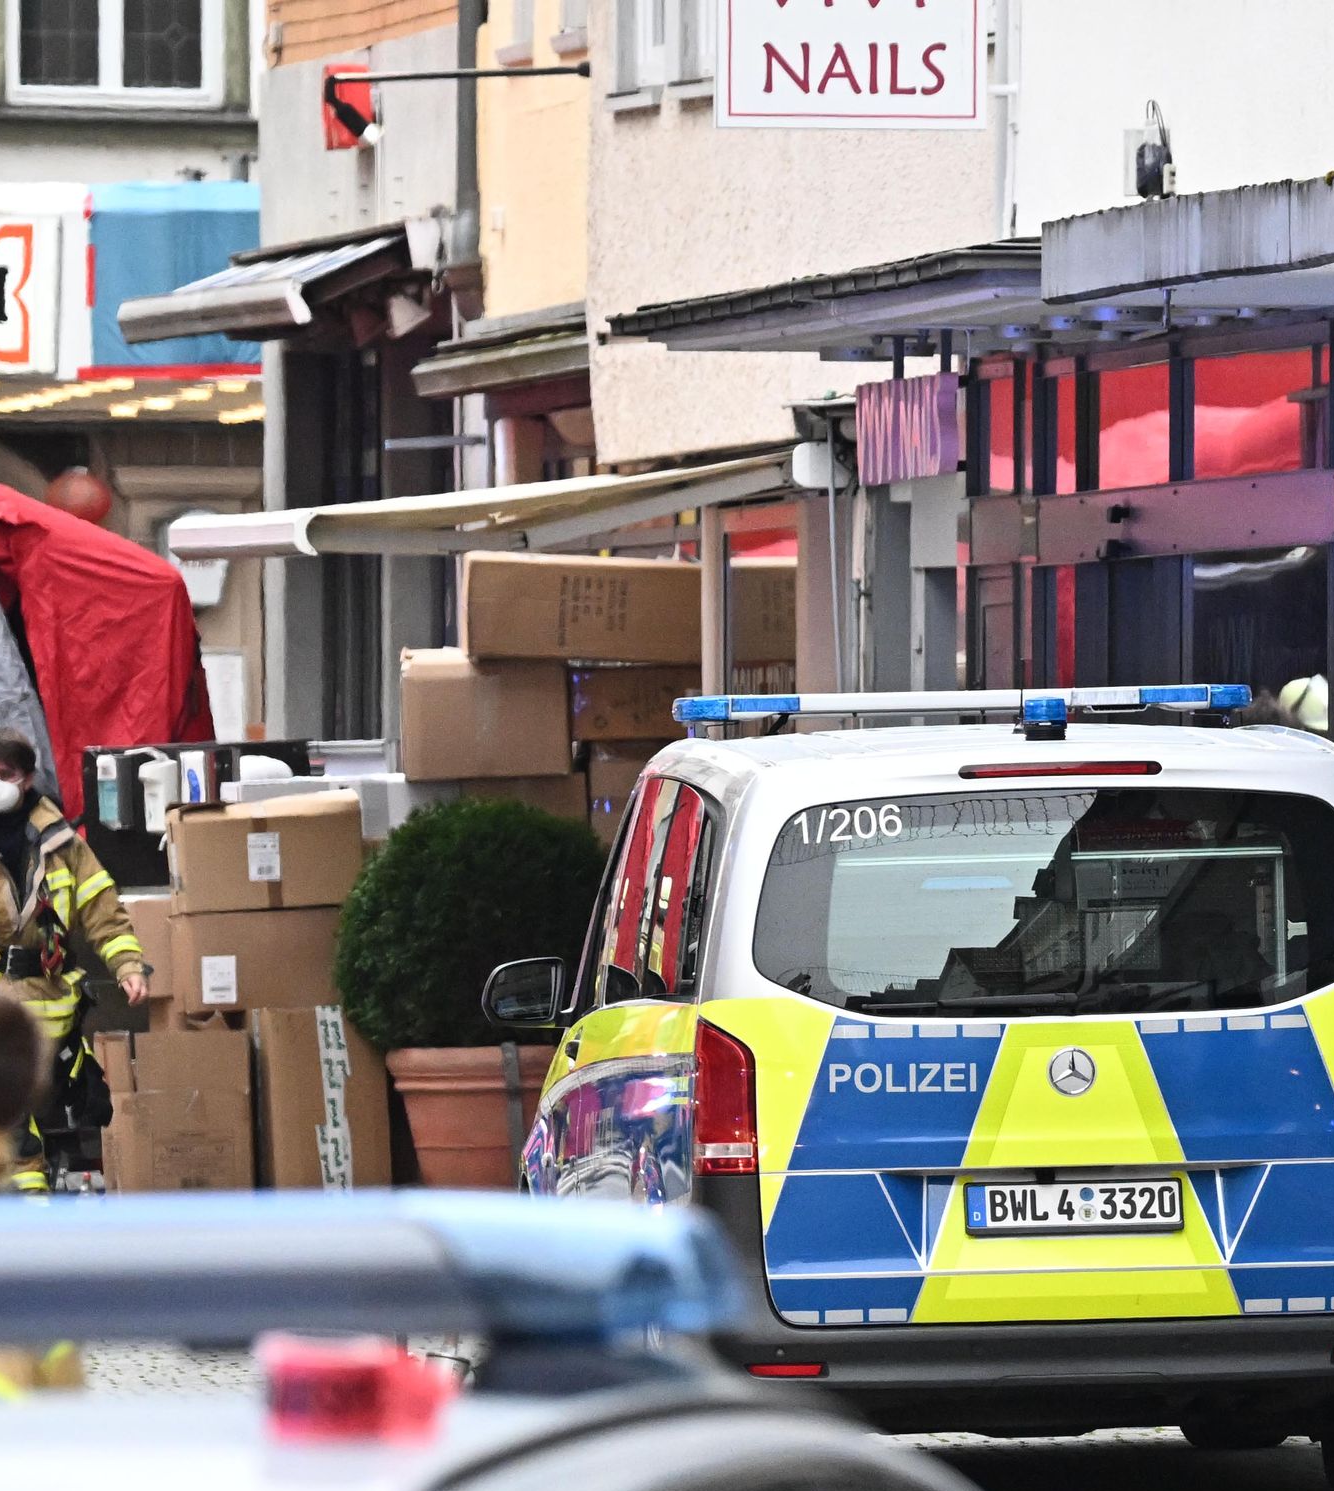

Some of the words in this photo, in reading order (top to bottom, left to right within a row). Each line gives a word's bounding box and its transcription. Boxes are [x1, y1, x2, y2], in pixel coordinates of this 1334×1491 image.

[763, 42, 947, 95] NAILS
[899, 374, 941, 480] NAILS
[791, 803, 903, 847] 1/206
[828, 1061, 978, 1095] POLIZEI
[988, 1188, 1049, 1223] BWL
[1057, 1187, 1075, 1221] 4
[1098, 1185, 1176, 1220] 3320
